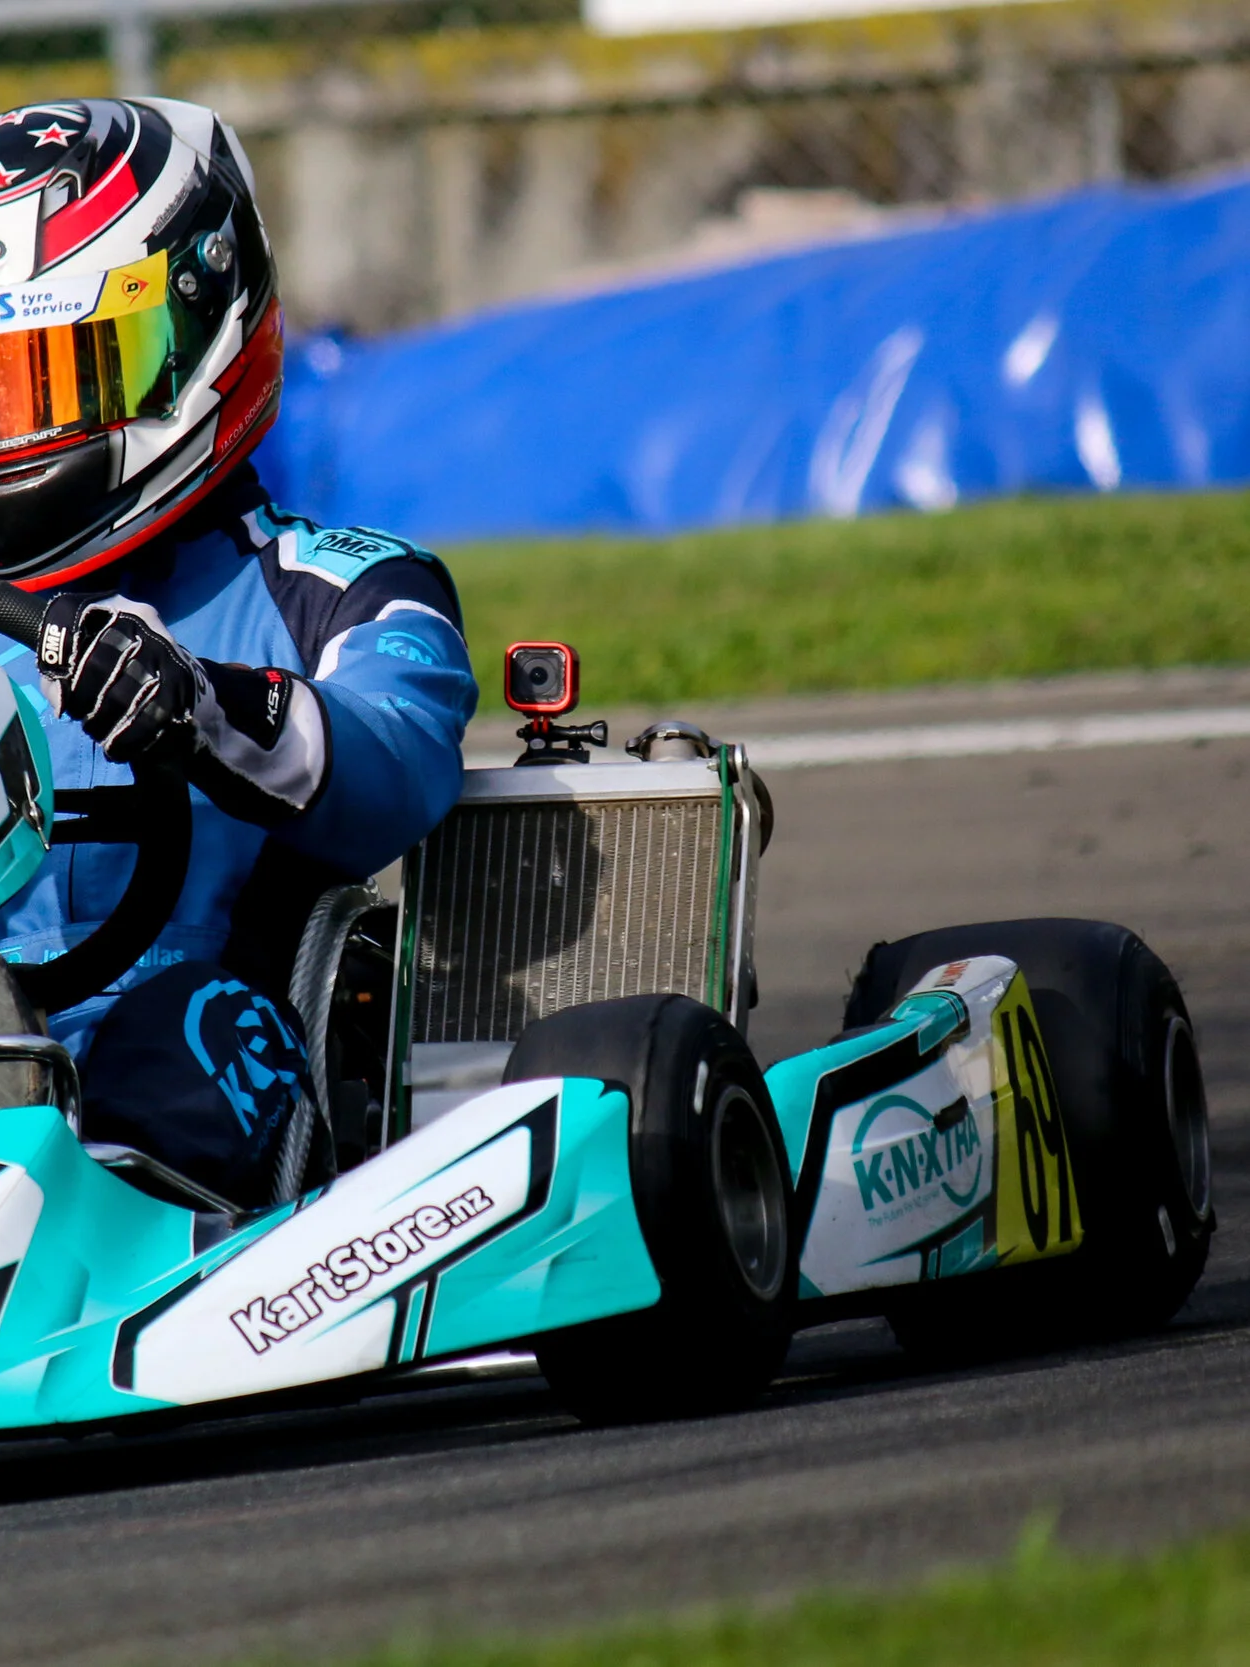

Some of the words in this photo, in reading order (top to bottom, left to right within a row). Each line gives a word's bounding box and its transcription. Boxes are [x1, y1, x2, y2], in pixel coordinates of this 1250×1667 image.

[21, 291, 53, 305] tyre
[22, 301, 83, 318] service
[314, 534, 382, 554] OMP
[44, 624, 63, 665] OMP
[230, 1186, 494, 1355] KartStore.nz
